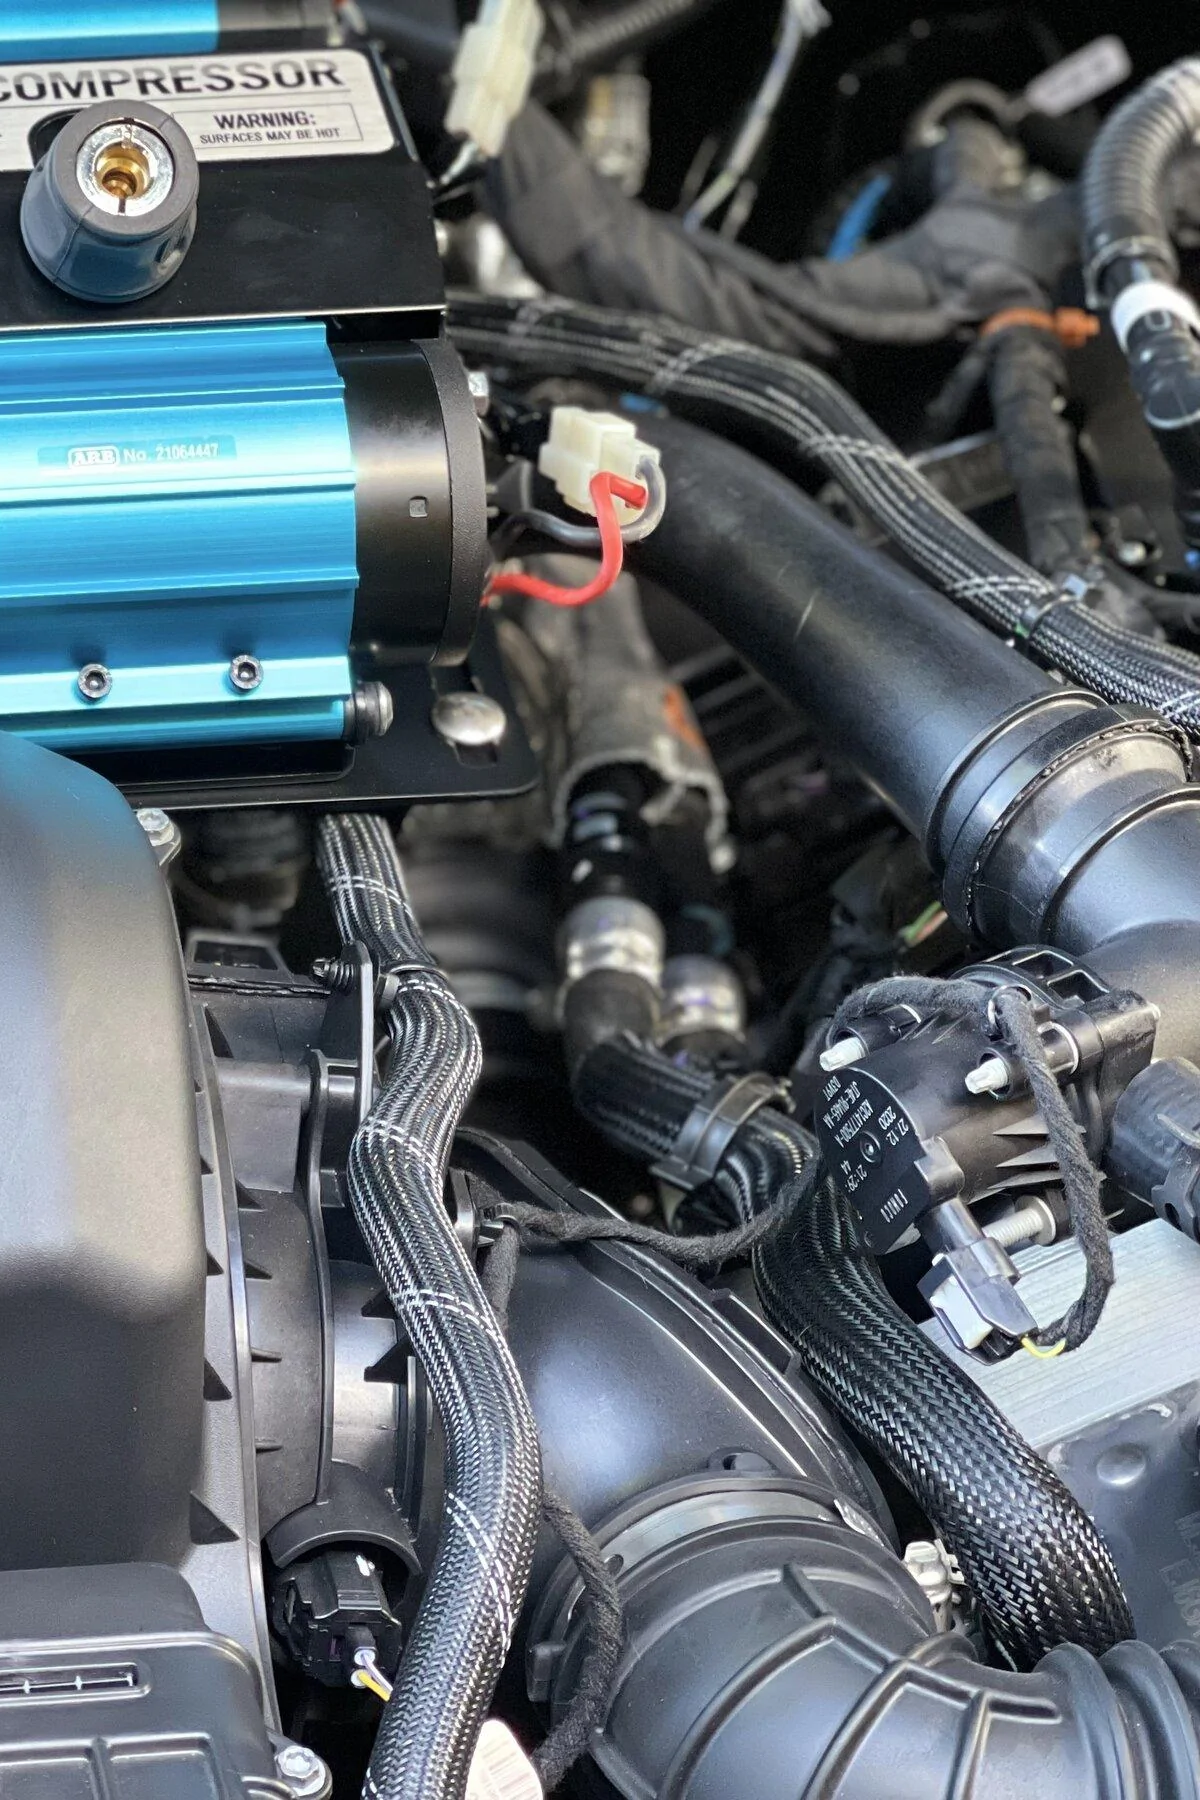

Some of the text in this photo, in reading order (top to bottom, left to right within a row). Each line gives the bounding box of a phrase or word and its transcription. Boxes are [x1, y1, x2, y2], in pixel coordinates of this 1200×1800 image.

[213, 110, 317, 130] WARNING:
[199, 127, 341, 145] SURFACES MAY BE HOT
[72, 443, 220, 467] ARB No. 21064447
[877, 1105, 897, 1130] 2020
